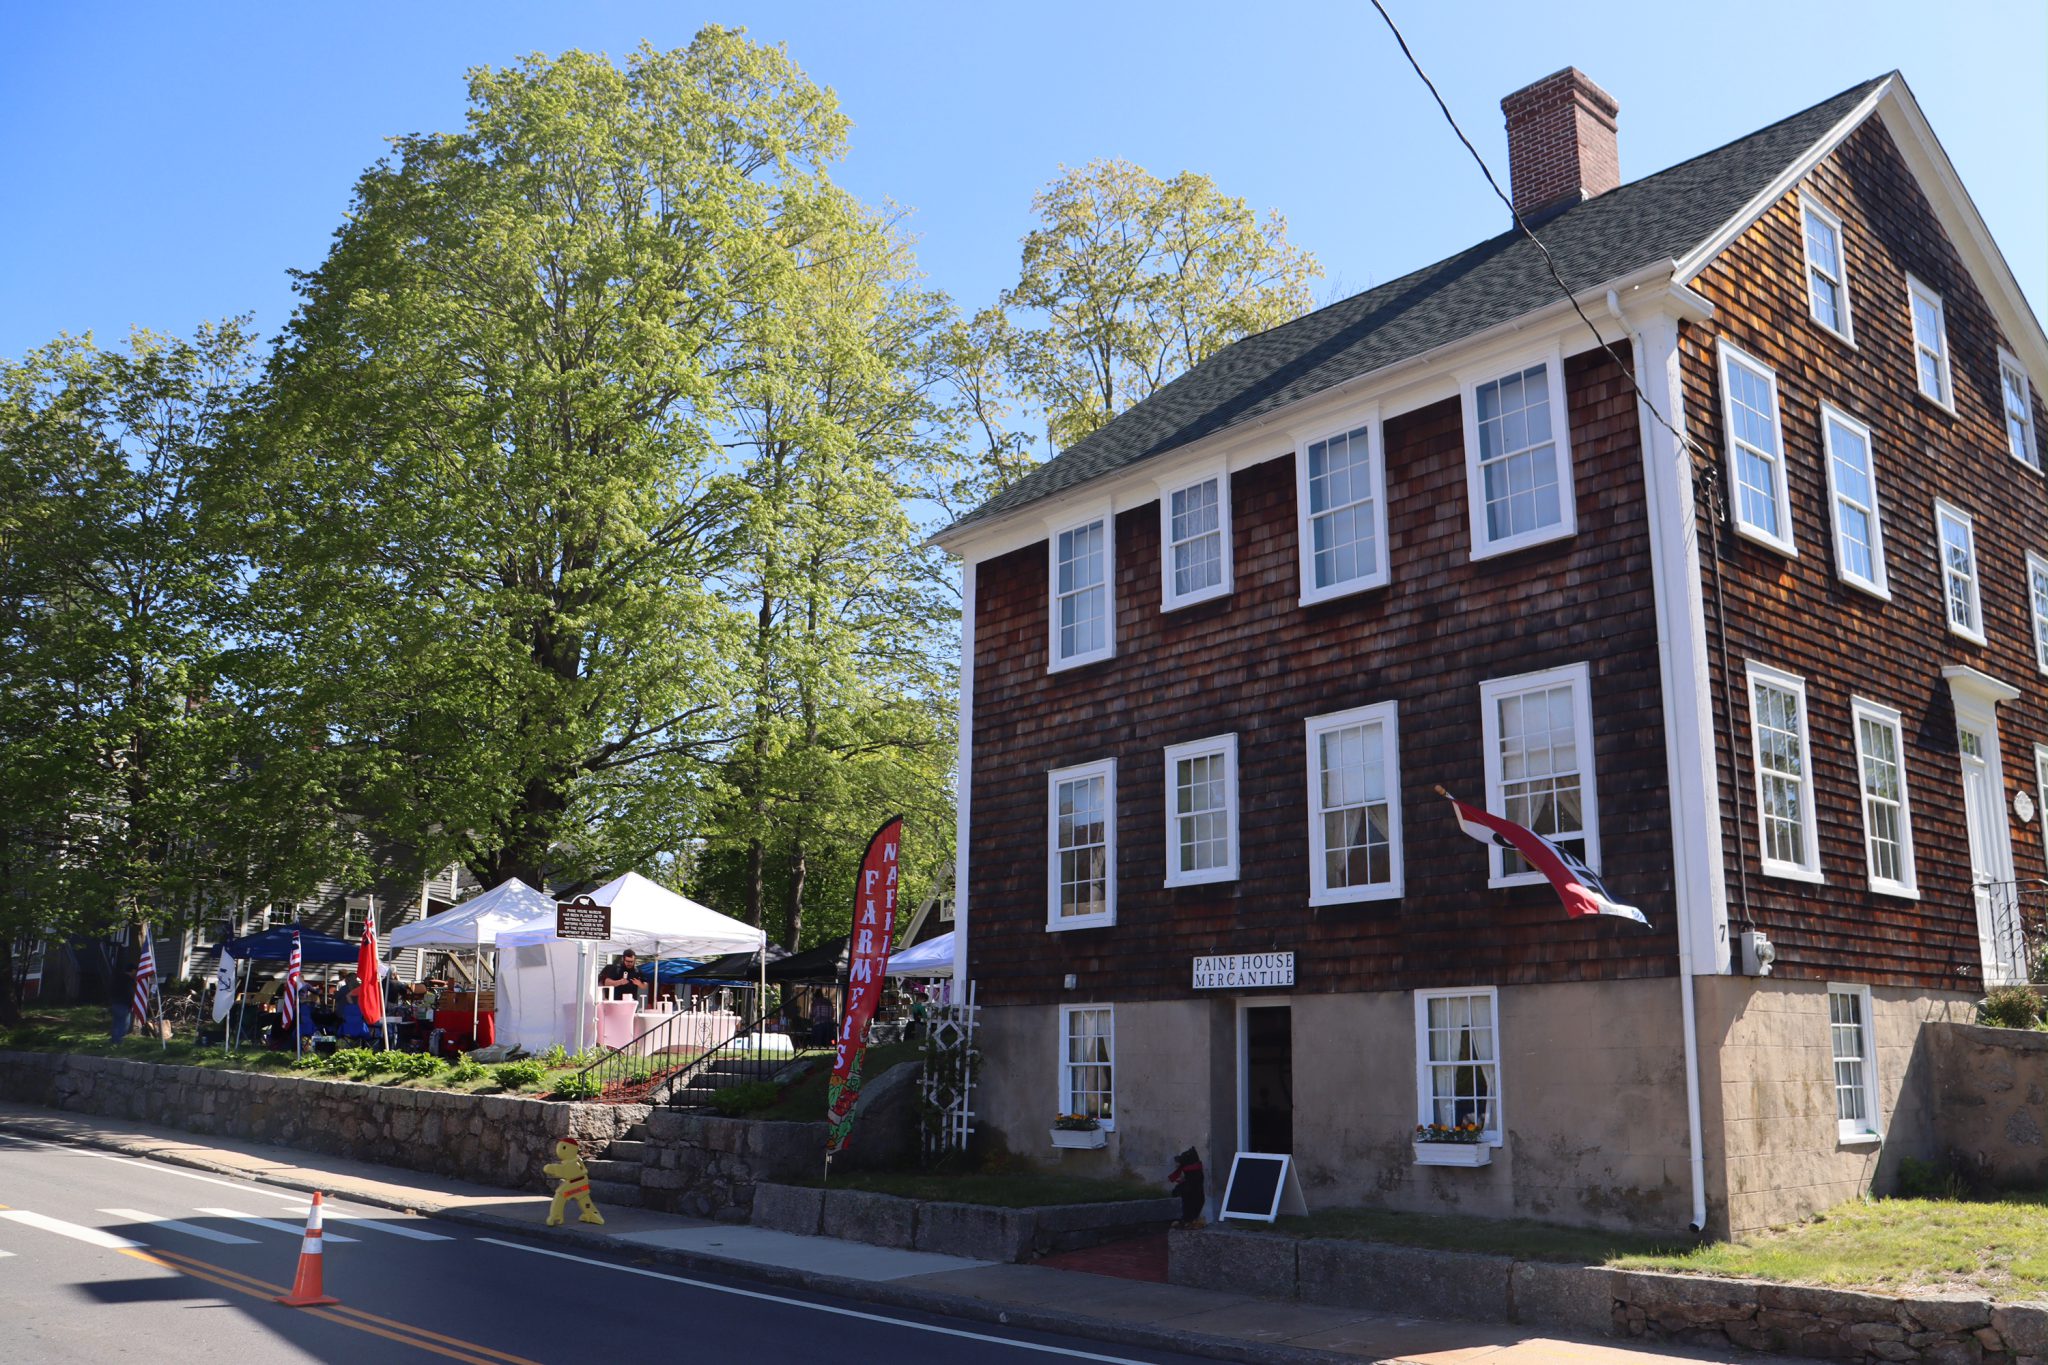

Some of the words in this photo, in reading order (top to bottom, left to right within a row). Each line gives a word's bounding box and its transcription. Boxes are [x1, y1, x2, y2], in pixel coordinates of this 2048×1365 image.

[1719, 924, 1726, 943] 7
[834, 869, 879, 1070] FARMERS
[1196, 957, 1235, 971] PAINE
[1242, 954, 1292, 970] HOUSE
[1196, 970, 1293, 986] MERCANTILE
